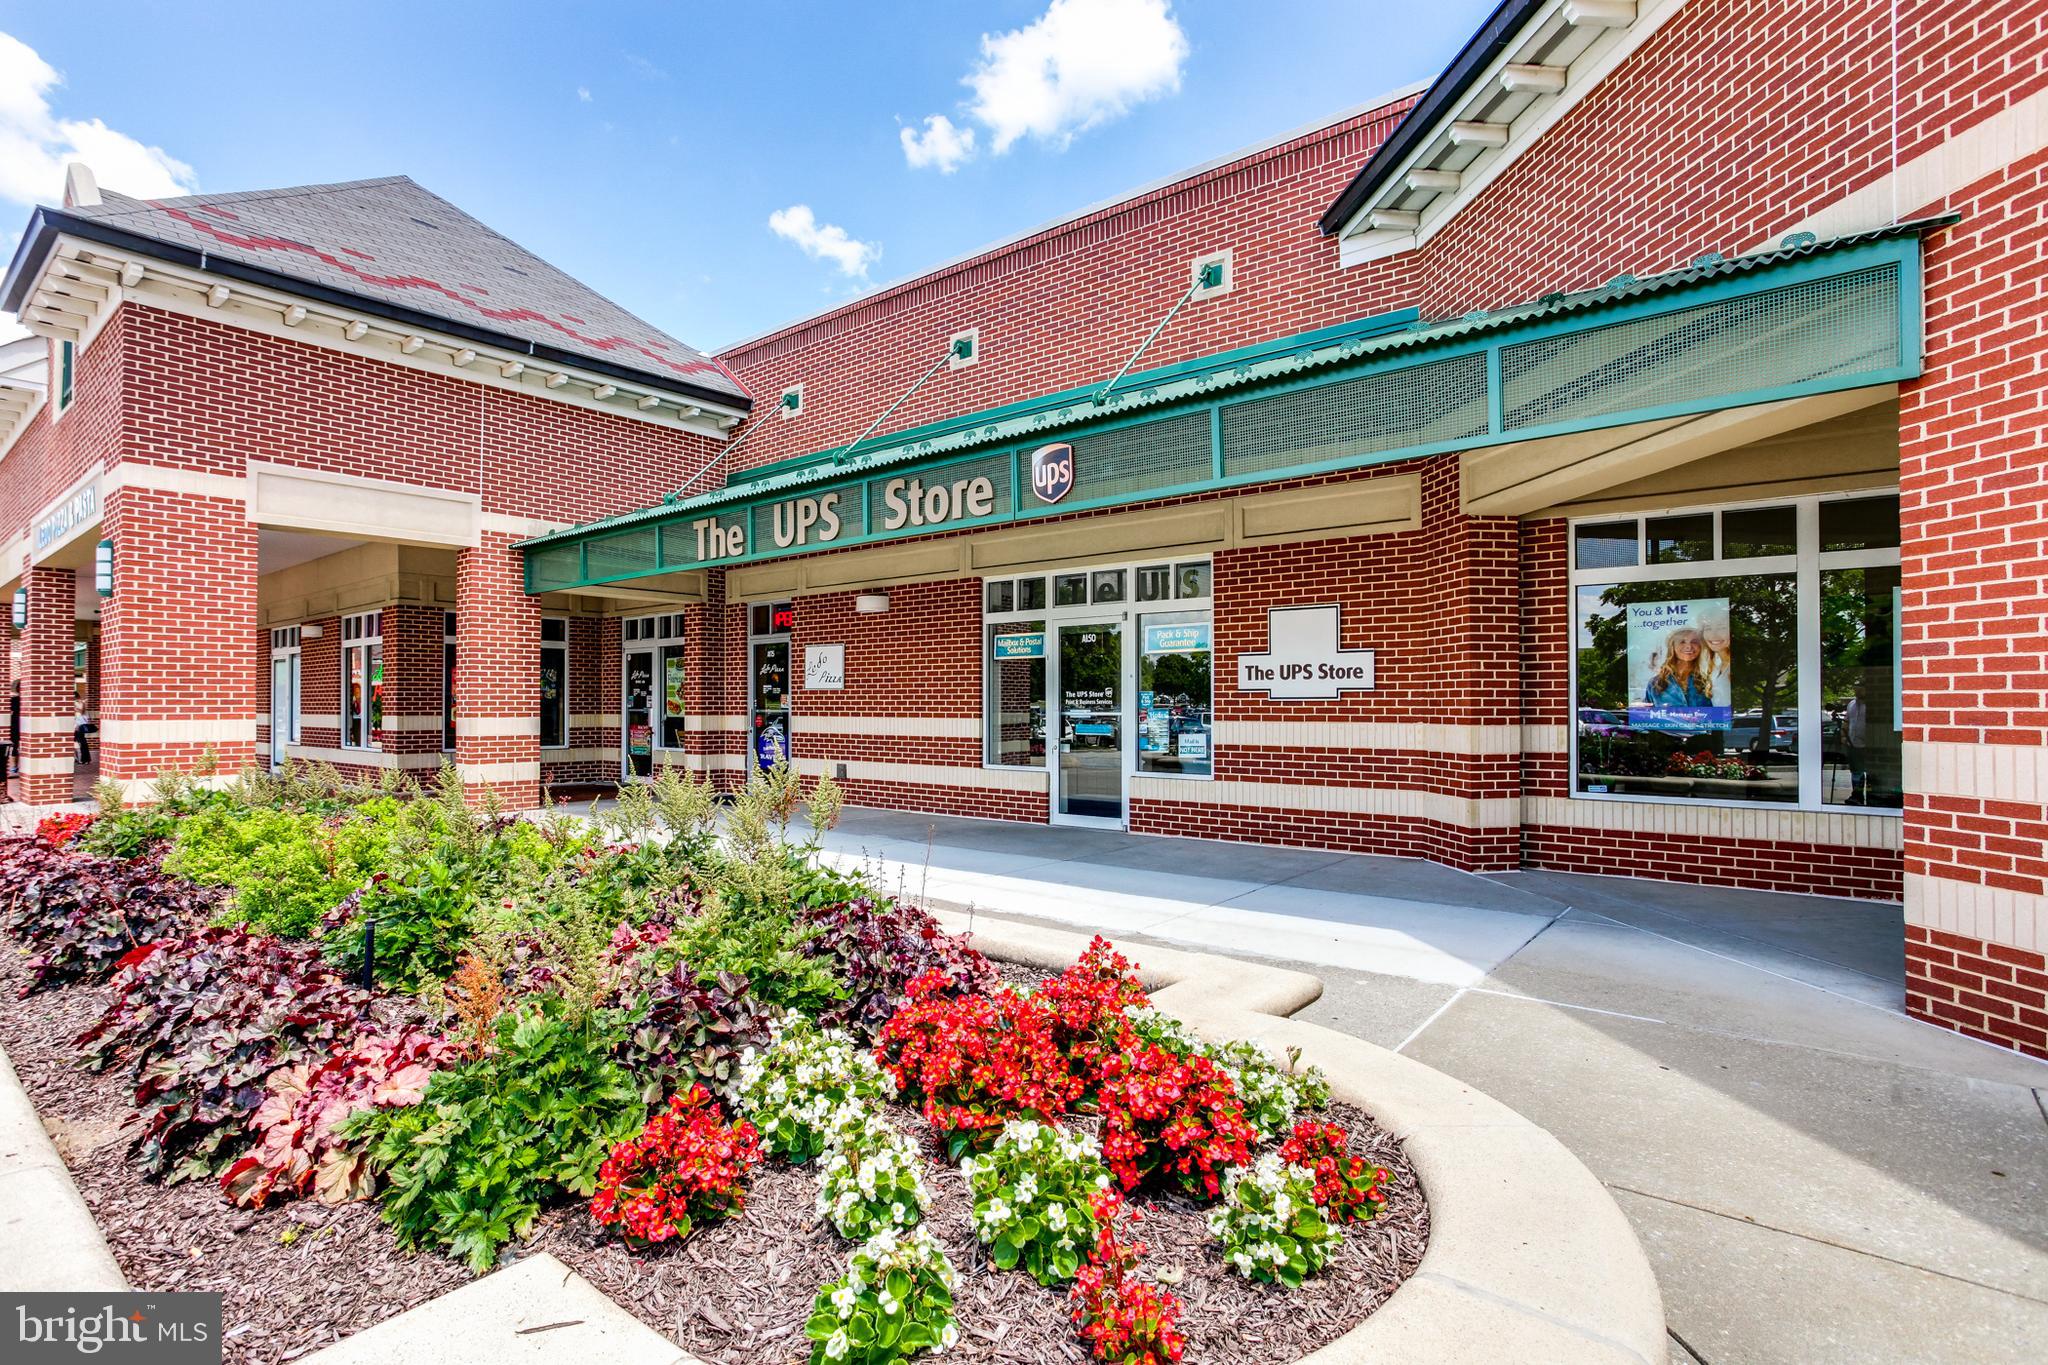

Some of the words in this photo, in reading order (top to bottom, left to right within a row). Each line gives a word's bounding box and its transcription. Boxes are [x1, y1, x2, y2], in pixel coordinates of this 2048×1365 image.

[75, 486, 96, 524] PASTA
[692, 517, 744, 561] The
[773, 493, 840, 548] UPS
[884, 477, 994, 530] Store
[1632, 607, 1652, 617] You
[1654, 606, 1663, 616] &
[1666, 604, 1688, 615] ME
[1157, 630, 1173, 639] Pack
[1175, 629, 1181, 638] &
[1183, 628, 1199, 639] Ship
[998, 639, 1019, 647] Mailbox
[1019, 638, 1025, 646] &
[1025, 637, 1042, 646] Postal
[1160, 639, 1195, 647] Guarantee
[1007, 646, 1032, 655] Solutions
[1245, 664, 1275, 681] The
[1279, 663, 1313, 680] UPS
[1318, 663, 1364, 680] Store
[1650, 709, 1666, 719] ME
